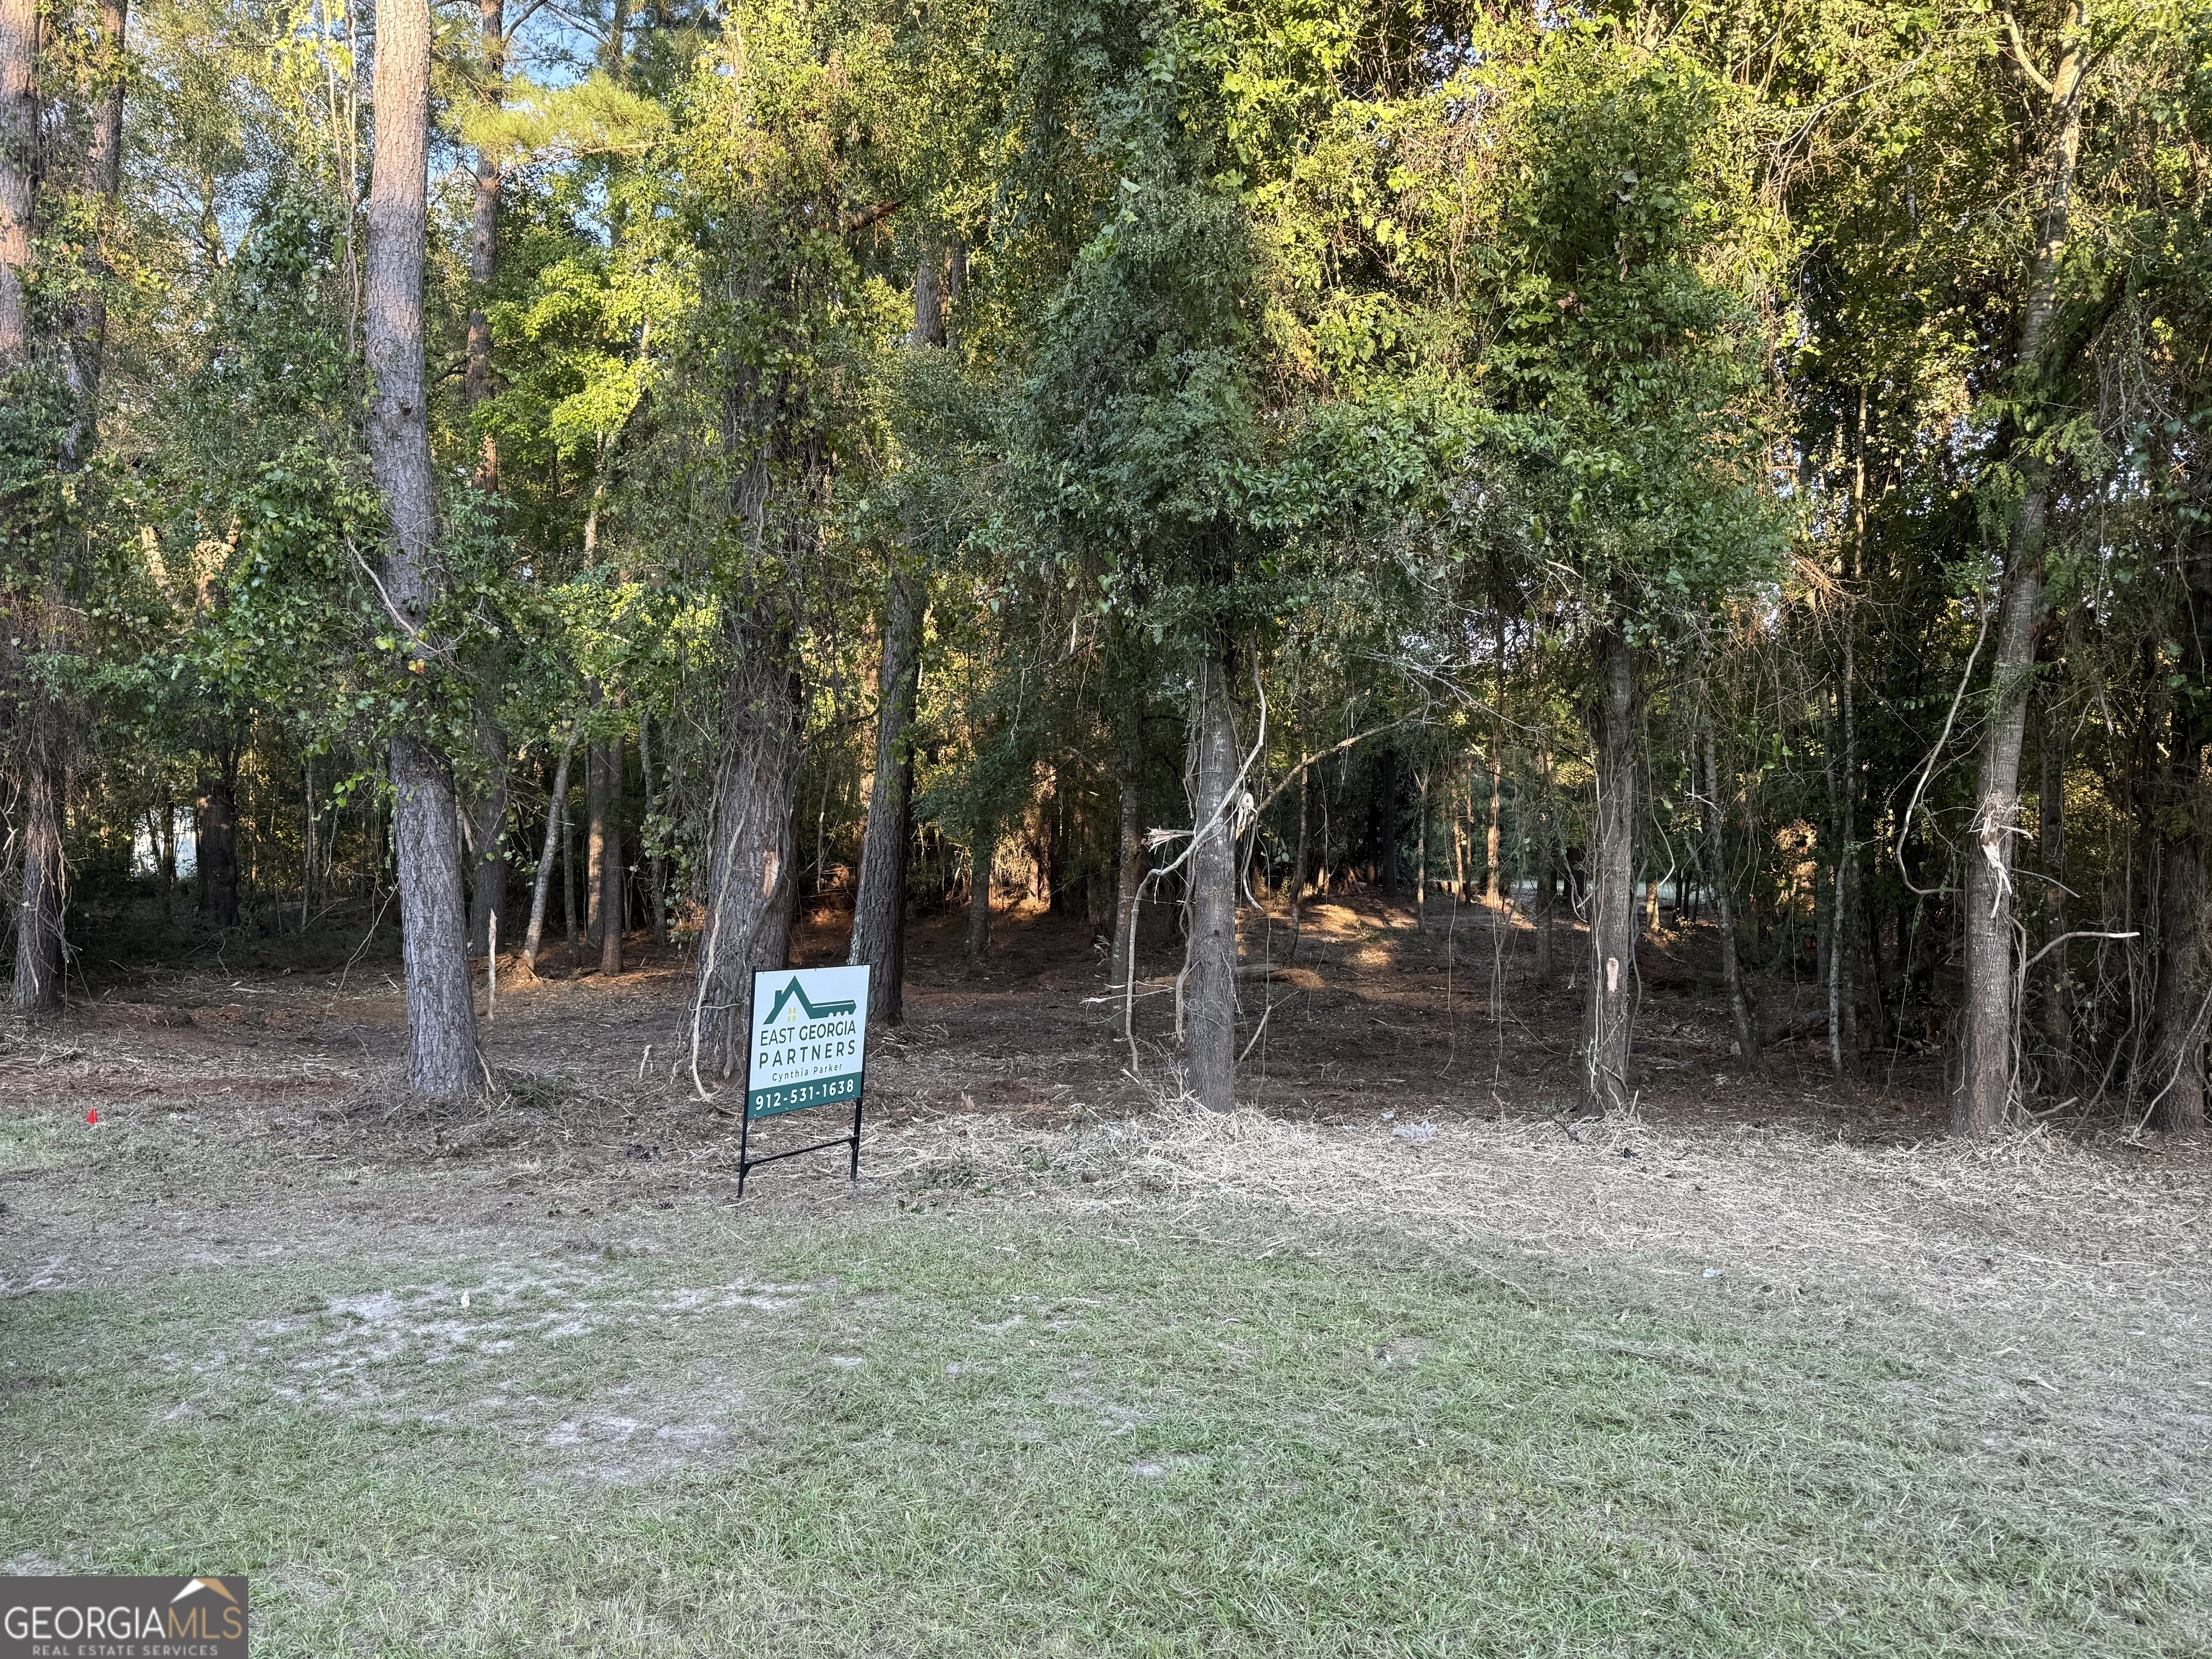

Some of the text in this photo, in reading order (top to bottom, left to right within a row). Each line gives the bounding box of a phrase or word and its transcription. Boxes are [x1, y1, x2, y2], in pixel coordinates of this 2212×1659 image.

[760, 1020, 856, 1046] EAST GEORGIA
[759, 1039, 855, 1069] PARTNERS
[772, 1063, 843, 1082] Cynthia Parker
[755, 1079, 855, 1111] 912-531-1638
